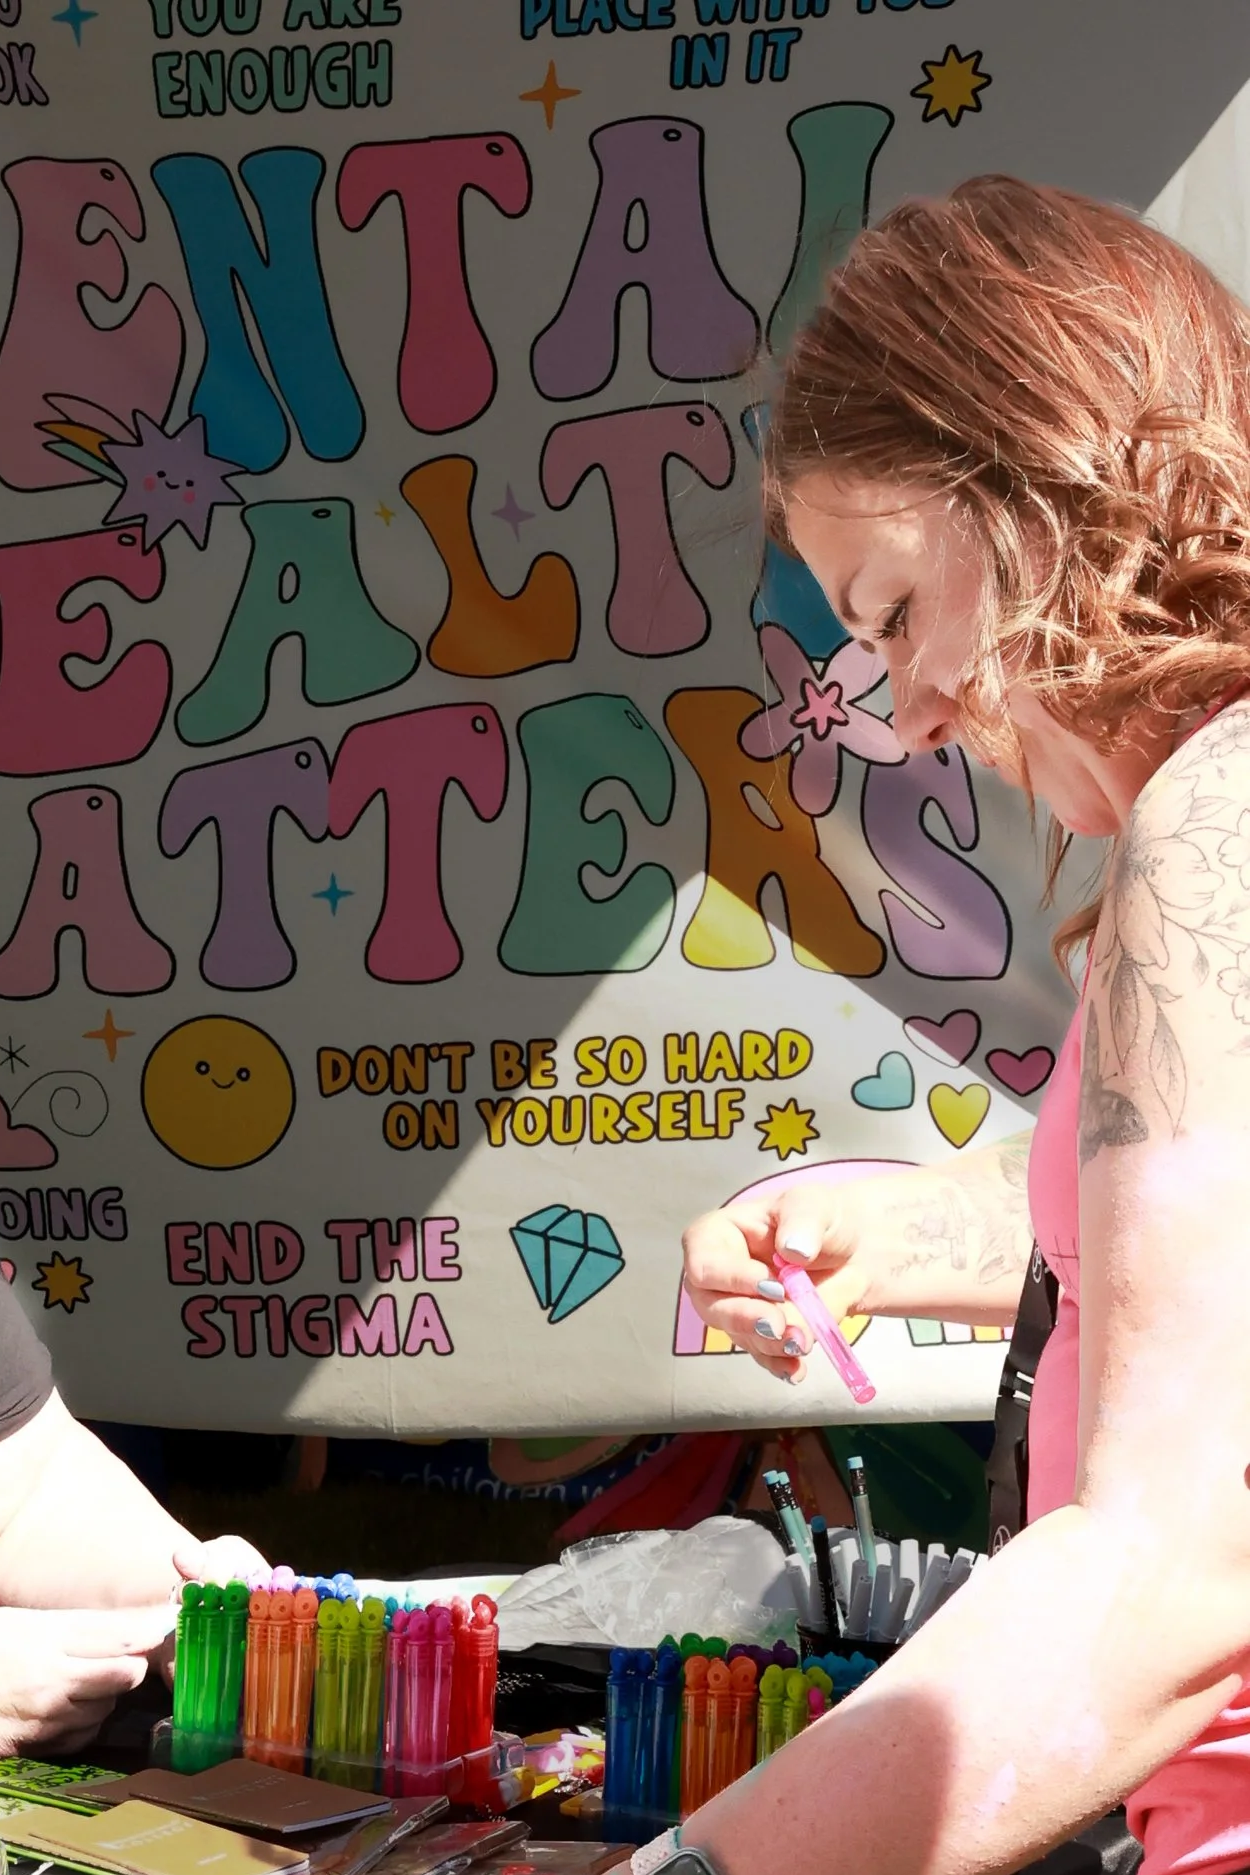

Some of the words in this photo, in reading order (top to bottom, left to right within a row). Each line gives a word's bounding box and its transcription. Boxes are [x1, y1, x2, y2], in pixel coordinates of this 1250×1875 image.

[152, 39, 393, 118] ENOUGH
[669, 33, 729, 90] IN
[745, 27, 802, 84] IT
[317, 1042, 474, 1098] DON'T
[491, 1038, 557, 1092] BE
[576, 1035, 646, 1088] SO
[664, 1028, 814, 1084] HARD
[382, 1101, 459, 1150] ON
[480, 1089, 746, 1148] YOURSELF
[166, 1222, 304, 1286] END
[327, 1216, 462, 1283] THE
[181, 1294, 454, 1359] STIGMA
